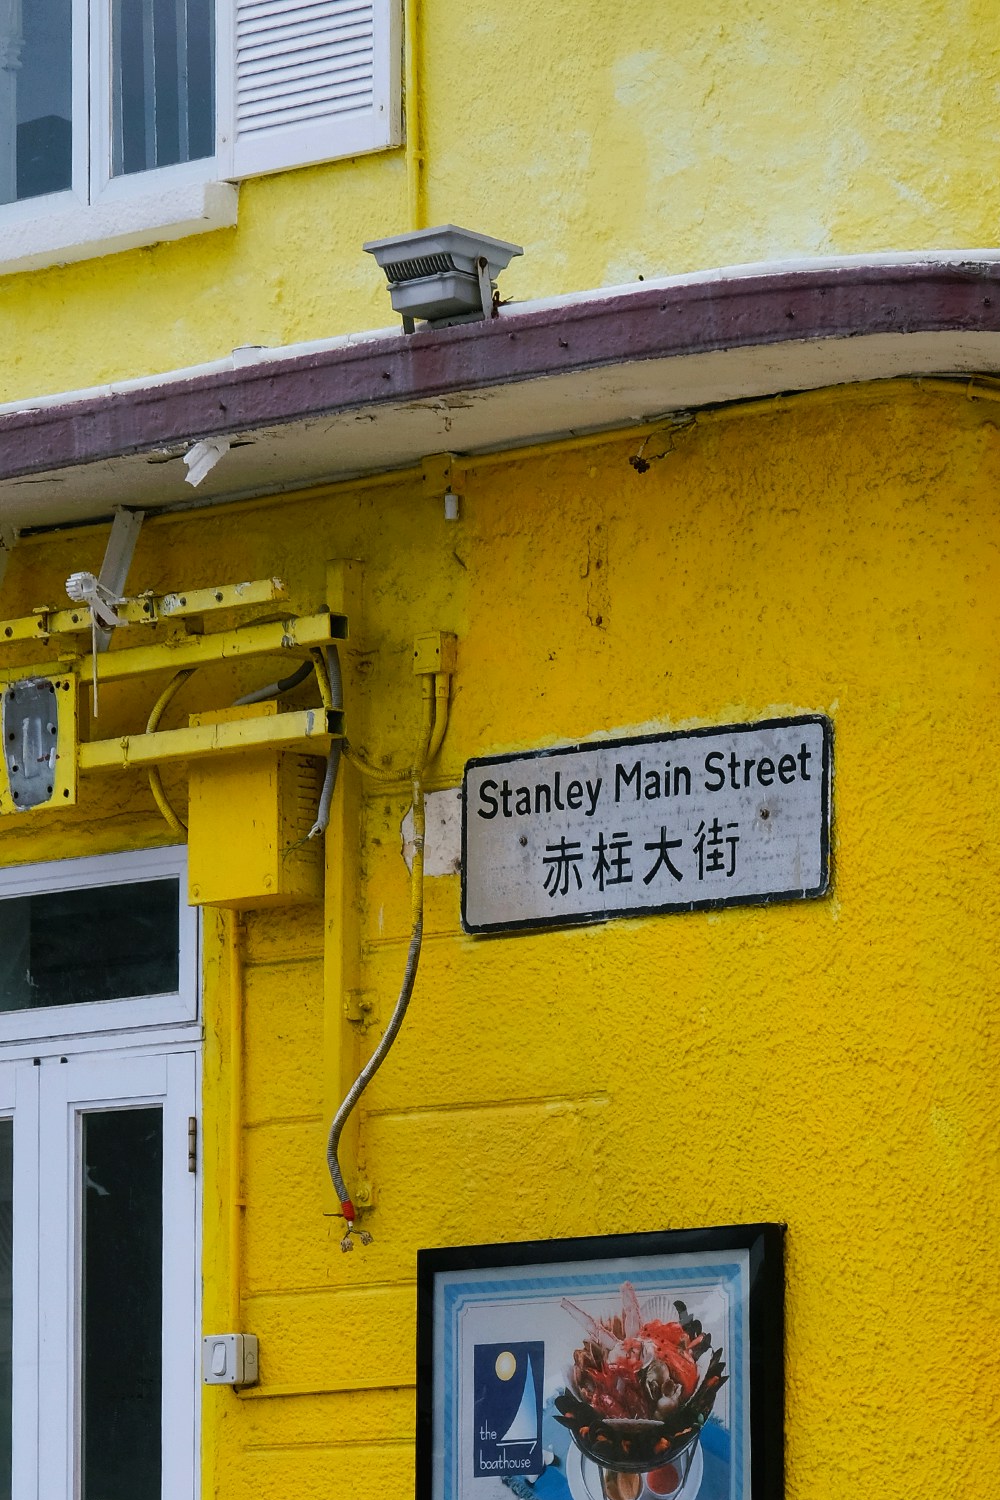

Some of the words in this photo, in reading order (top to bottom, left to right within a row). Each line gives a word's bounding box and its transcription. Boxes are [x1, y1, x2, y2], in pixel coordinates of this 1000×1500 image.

[477, 771, 603, 819] Stanley
[615, 760, 692, 803] Main
[704, 743, 812, 792] Street
[542, 817, 740, 898] 赤柱大街
[479, 1419, 498, 1441] the
[479, 1447, 532, 1470] boathouse
